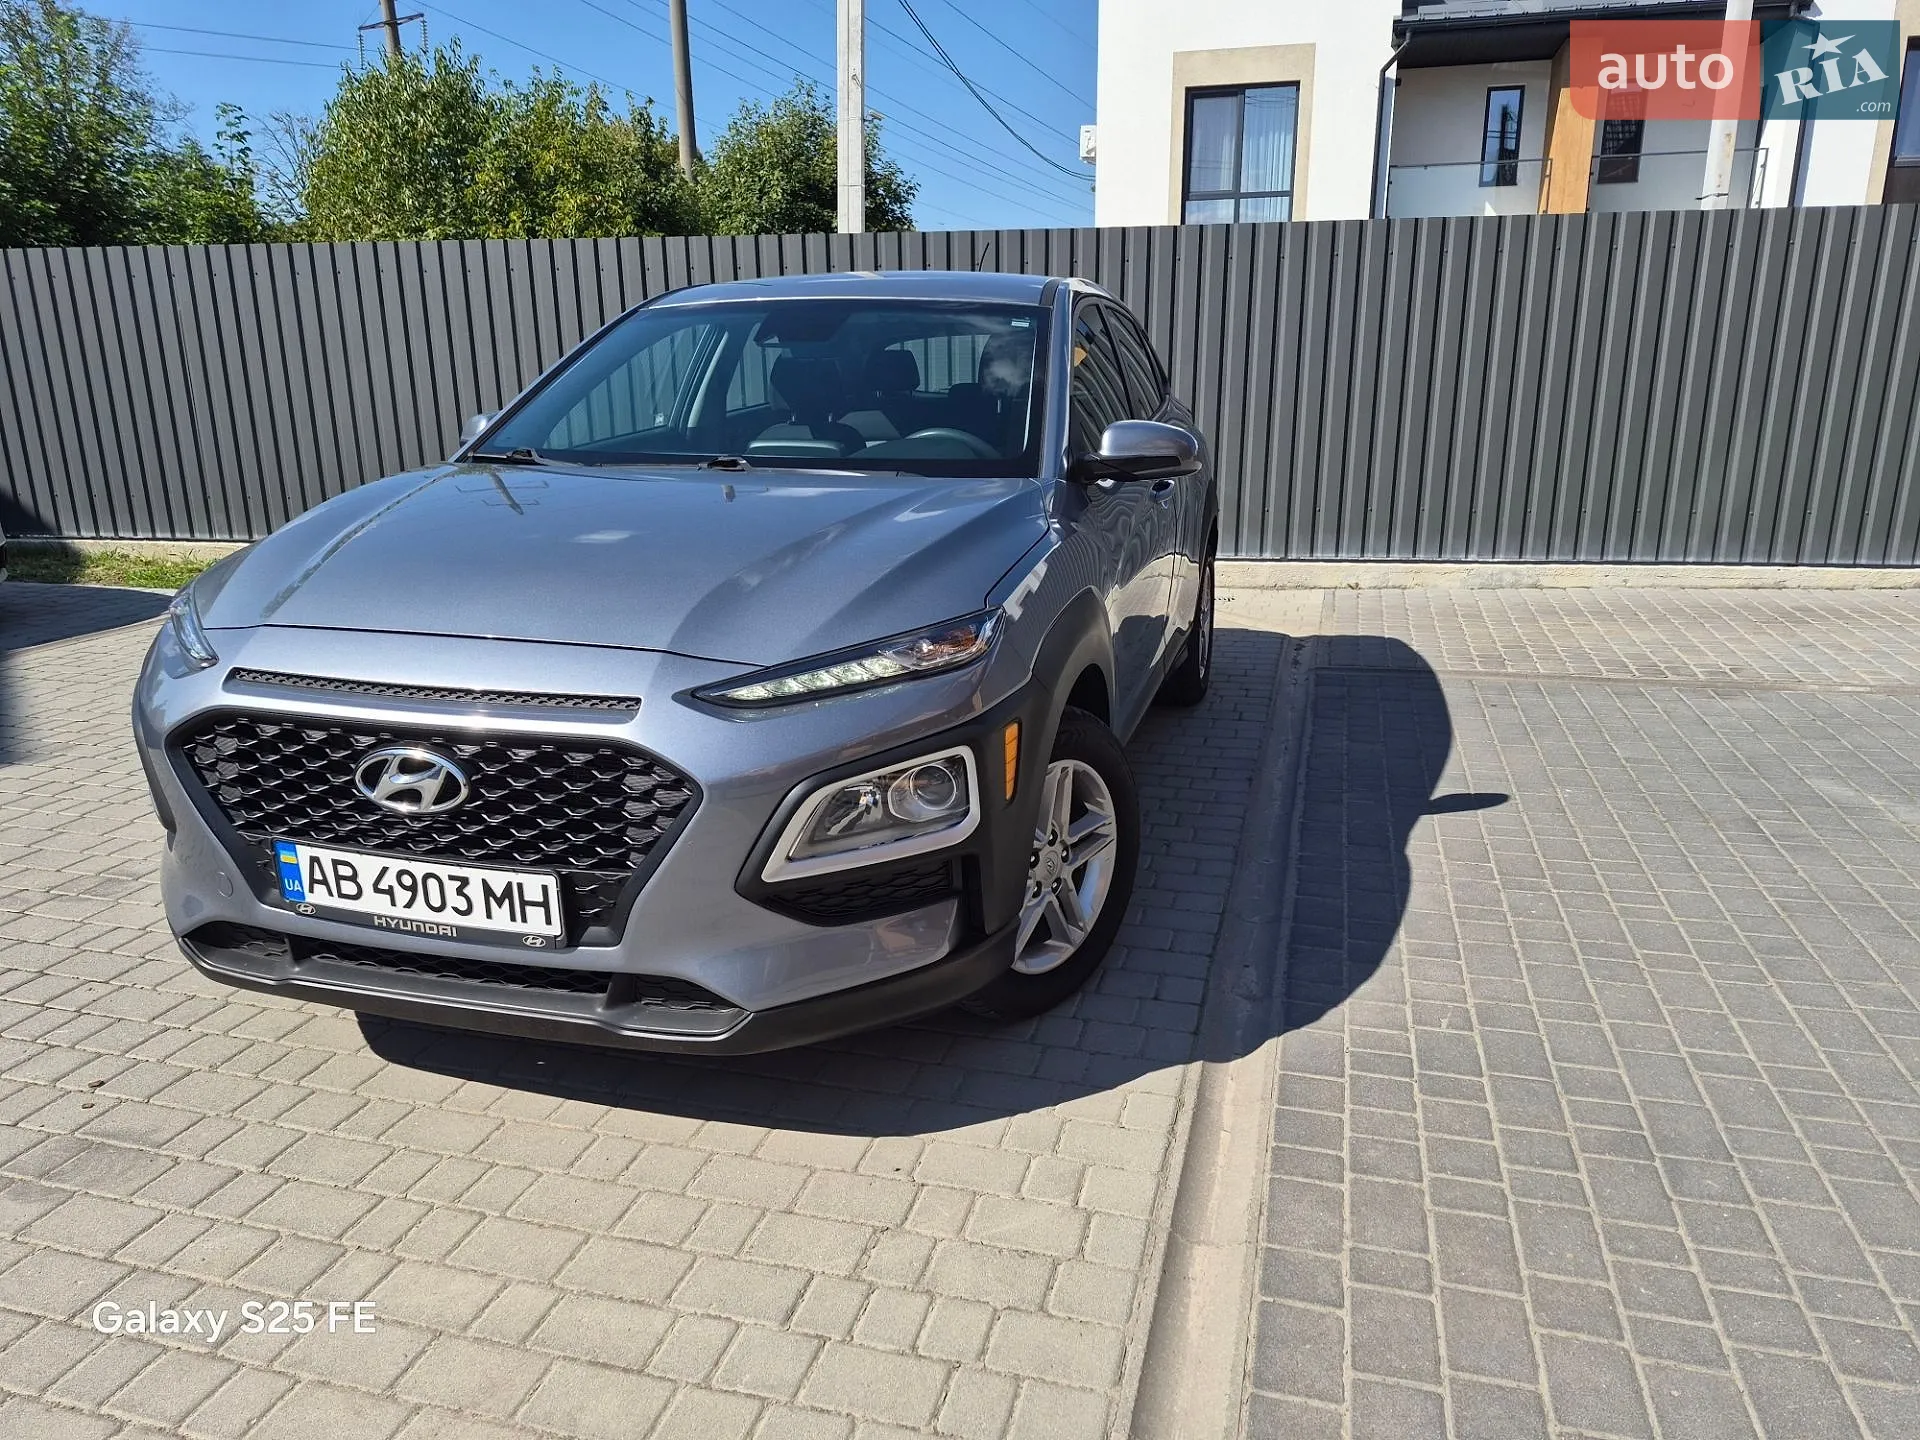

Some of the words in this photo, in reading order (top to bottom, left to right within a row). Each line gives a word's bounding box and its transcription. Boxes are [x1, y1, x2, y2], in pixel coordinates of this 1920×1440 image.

[285, 878, 302, 892] UA
[308, 856, 363, 901] AB
[372, 866, 473, 917] 4903
[482, 878, 552, 926] MH
[374, 916, 457, 938] HYUNDAI
